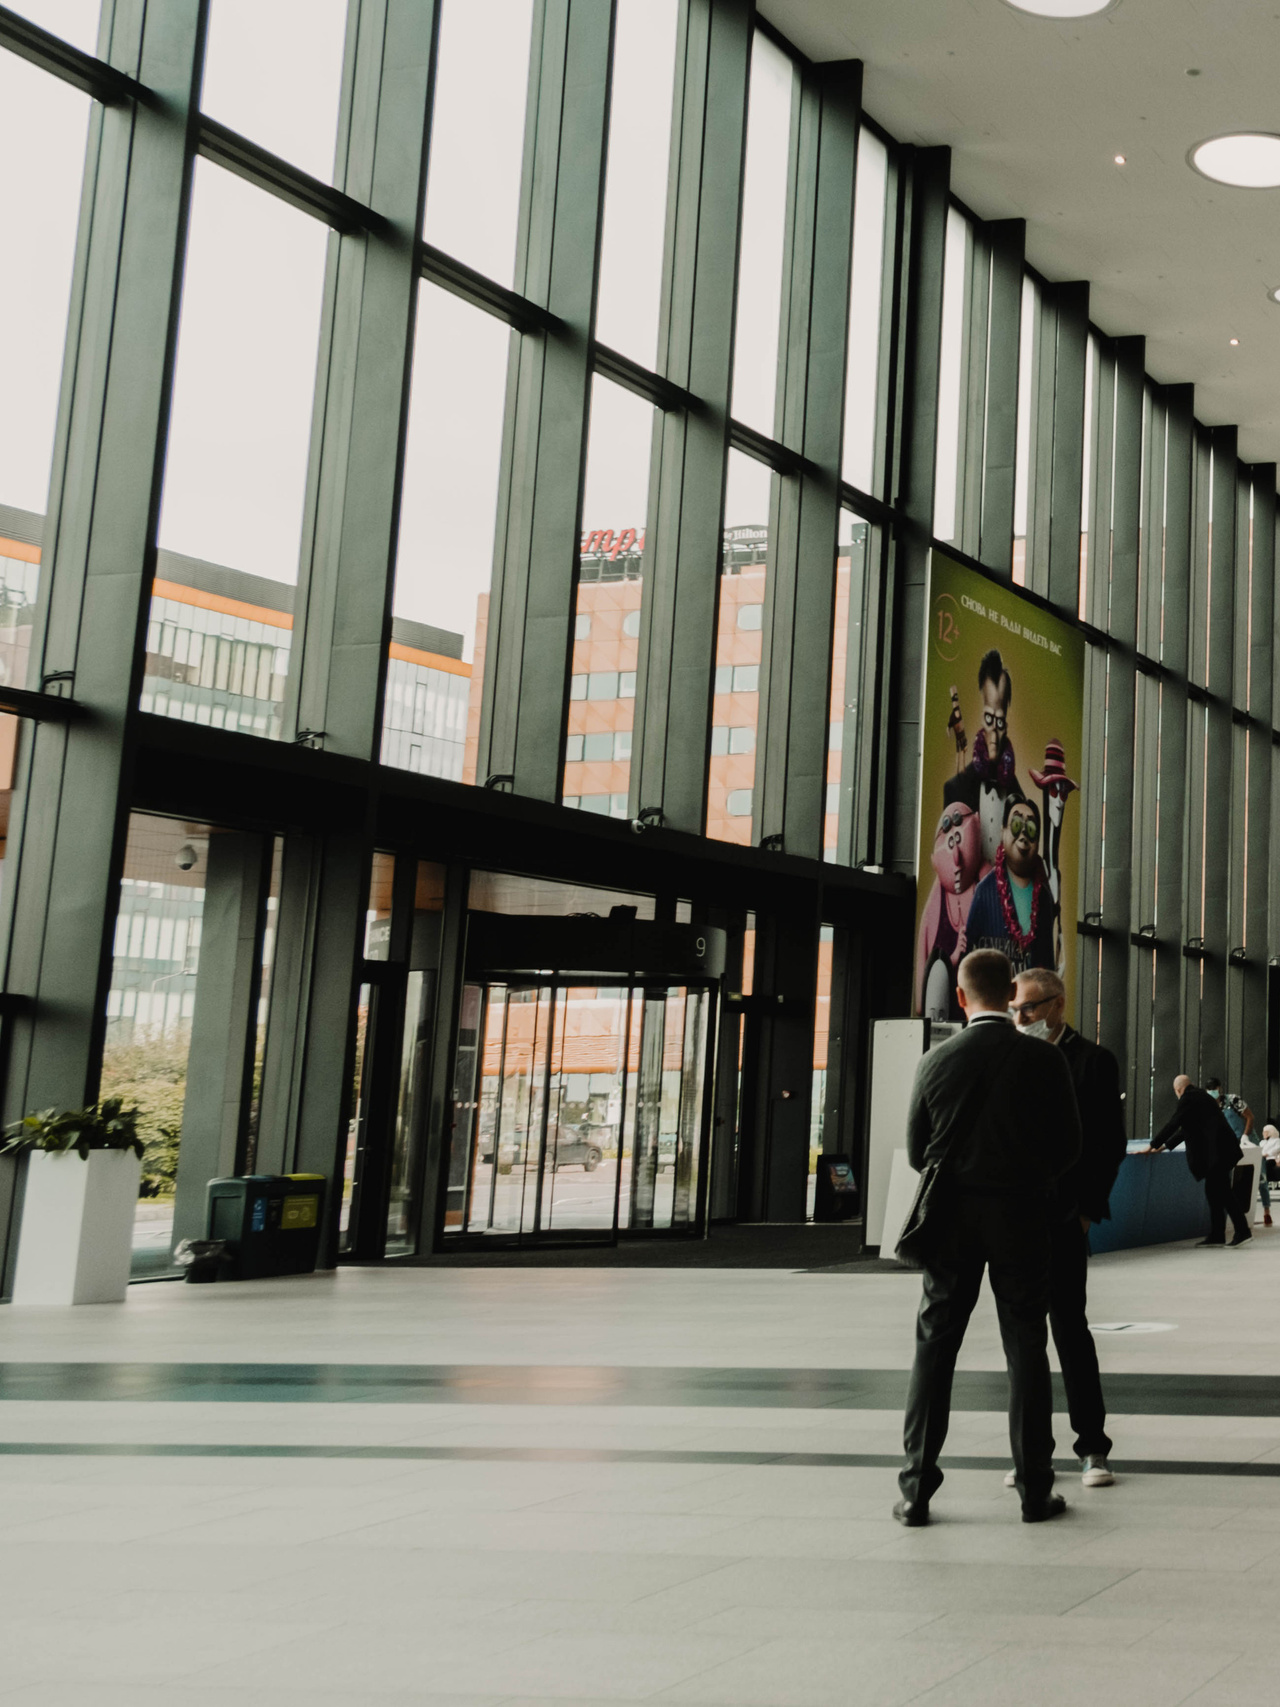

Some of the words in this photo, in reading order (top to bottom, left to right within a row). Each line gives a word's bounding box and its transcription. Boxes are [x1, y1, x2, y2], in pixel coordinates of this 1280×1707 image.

[938, 609, 960, 644] 12+
[961, 594, 986, 617] СНОВА
[988, 608, 1000, 624] НЕ
[1000, 615, 1021, 635] РАДЫ
[1022, 627, 1049, 649] ВИДЕТЬ
[1049, 640, 1063, 657] ВАС
[695, 936, 706, 958] 9
